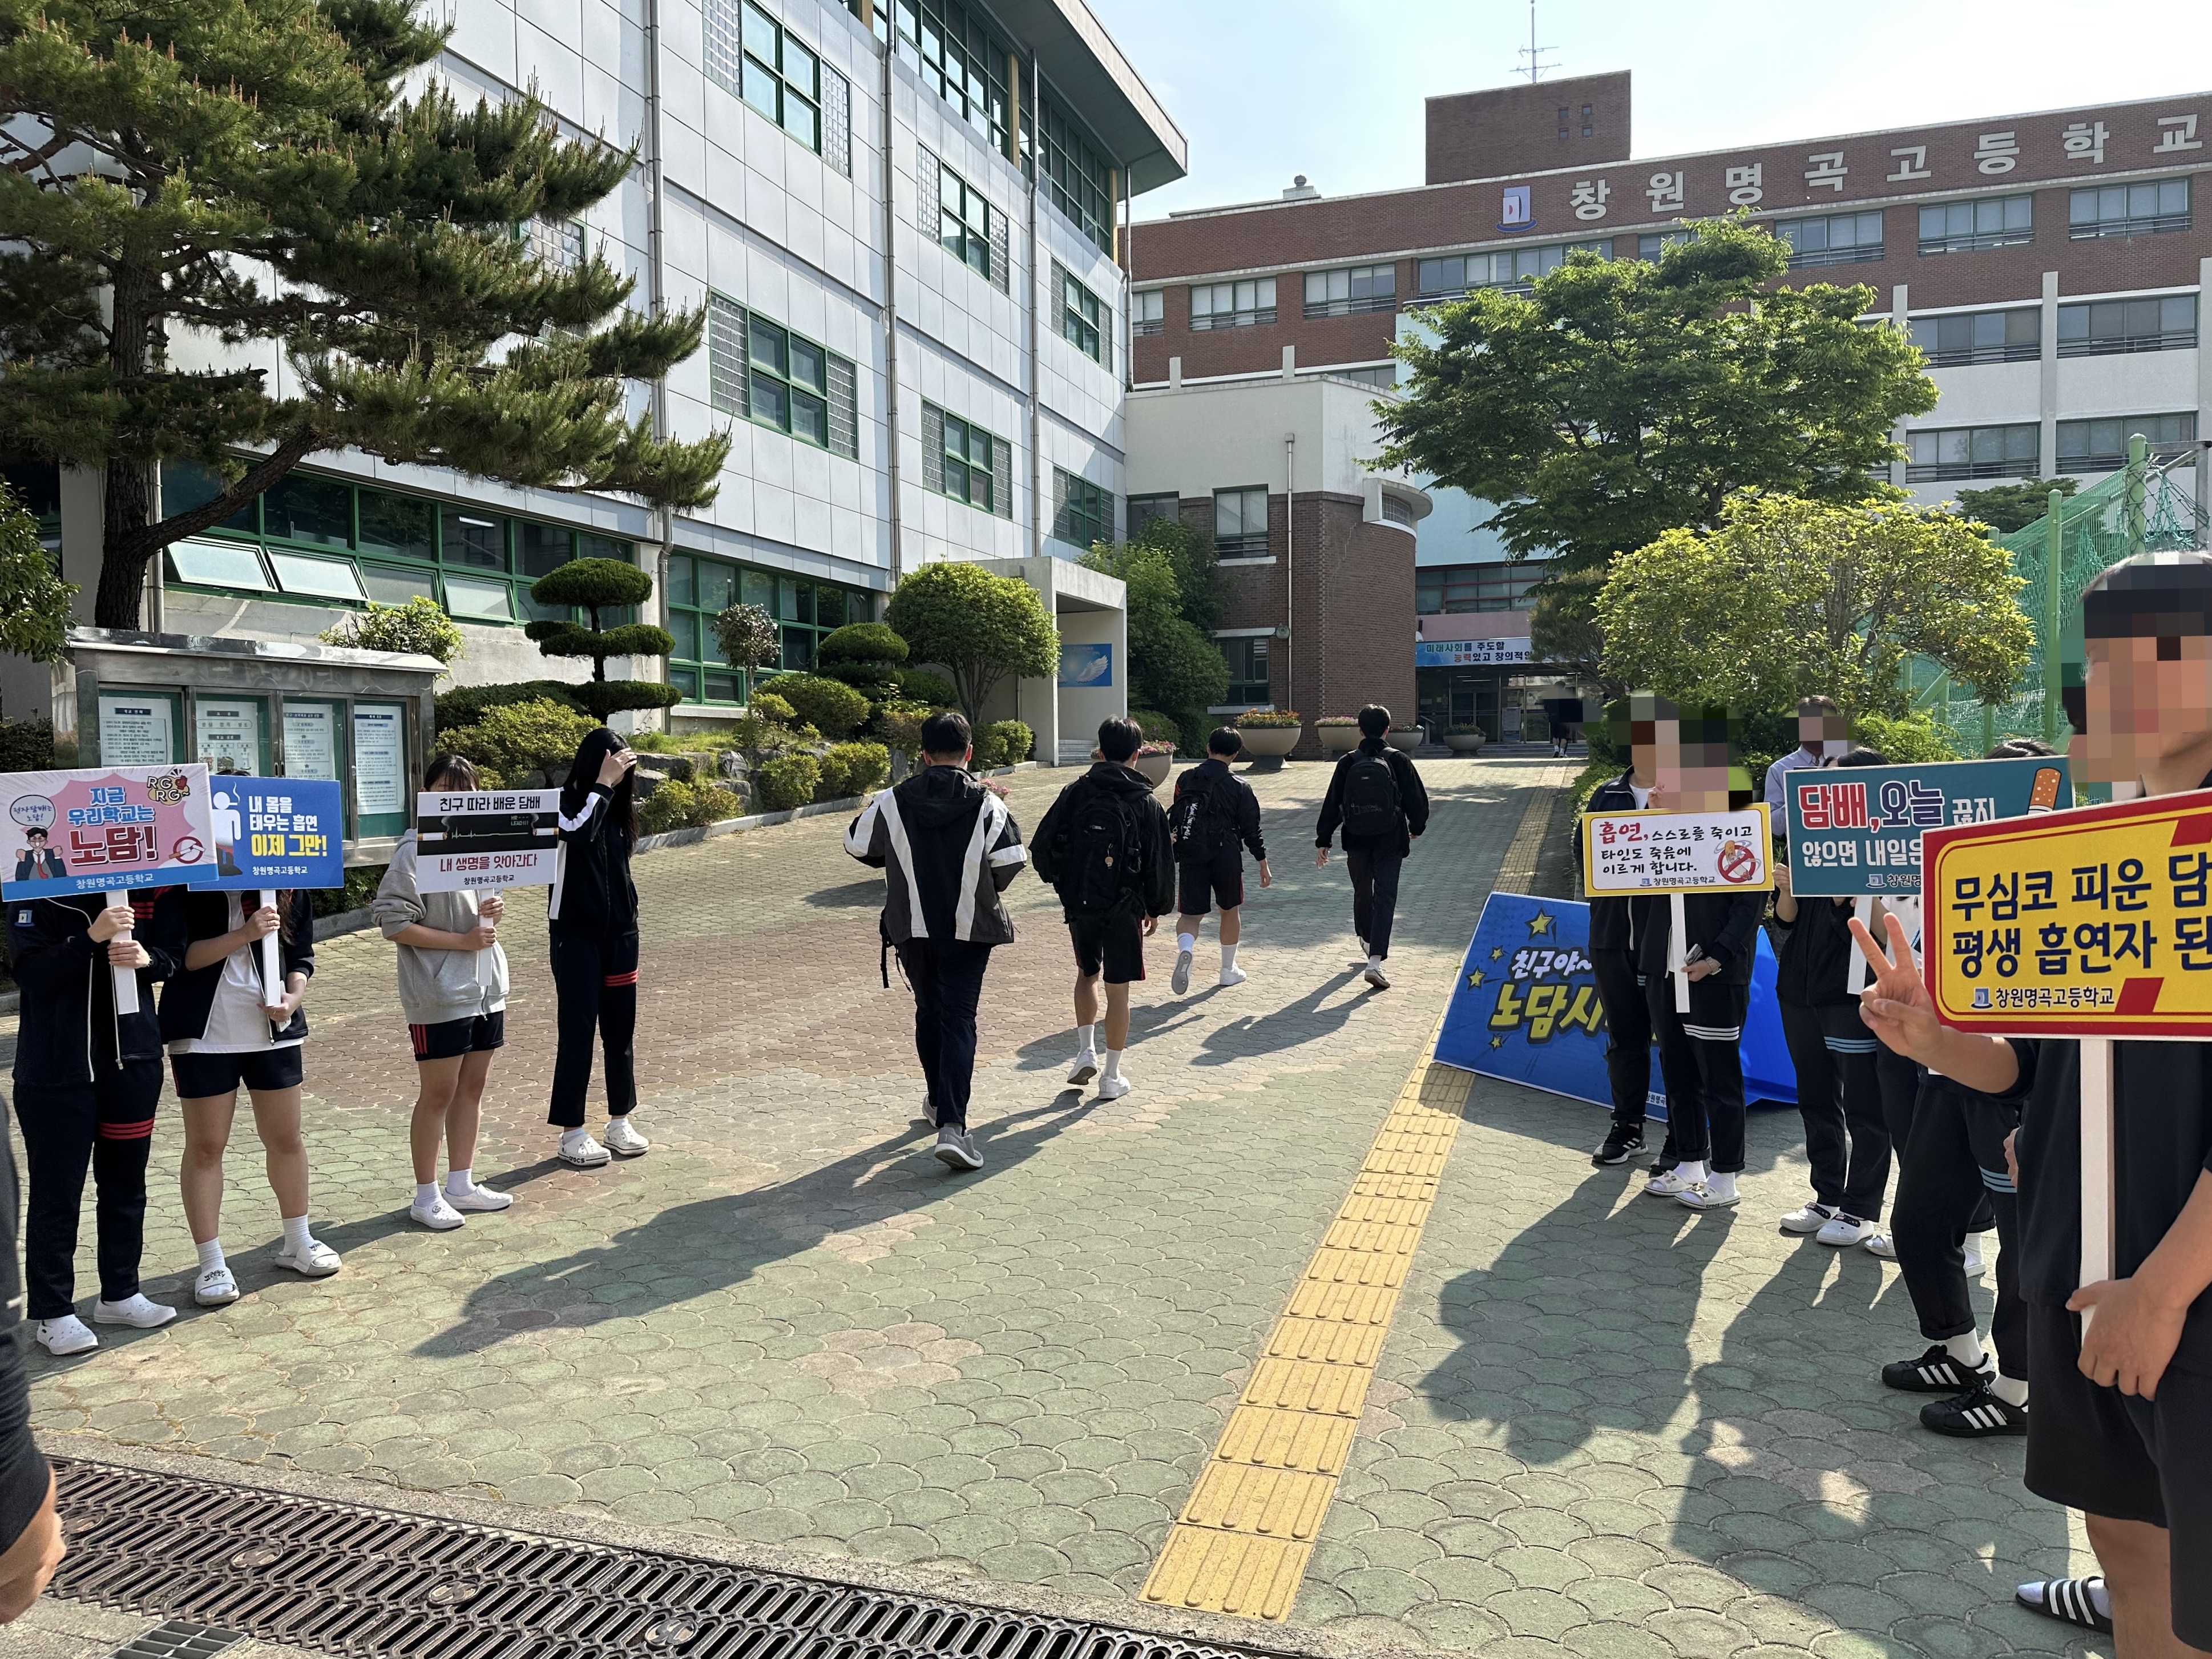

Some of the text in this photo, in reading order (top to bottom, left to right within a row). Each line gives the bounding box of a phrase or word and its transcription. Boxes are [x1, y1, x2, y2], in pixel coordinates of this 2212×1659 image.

[1569, 113, 2202, 221] 창원명곡고등학교
[1426, 641, 1505, 653] 미래사회를 주도할
[1454, 653, 1491, 663] 능력있고
[147, 775, 173, 790] RG
[90, 786, 126, 806] 지금
[249, 796, 292, 813] 내 몸을
[440, 796, 540, 812] 친구 따라 배운 담배
[68, 805, 155, 827] 우리학교는
[1952, 797, 1995, 825] 끊지
[249, 814, 318, 831] 태우는 흡연
[1599, 821, 1752, 844] 흡연, 스스로를 죽이고
[69, 826, 159, 866] 노담!
[251, 834, 327, 857] 이제 그만!
[1601, 846, 1691, 861] 타인도 죽음에
[1802, 839, 1858, 867] 않으면
[252, 866, 308, 875] 창원명곡고등학교
[440, 854, 538, 872] 내 생명을 앗아간다
[1603, 861, 1697, 875] 이르게 합니다.
[75, 874, 155, 890] 창원명곡고등학교
[464, 875, 515, 885] 창원명곡고등학교
[1653, 876, 1715, 886] 창원명곡고등학교
[1951, 851, 2212, 922] 무심코 피운 담
[1952, 927, 2021, 979] 평생
[2035, 920, 2157, 976] 흡연자
[1995, 986, 2116, 1008] 창원명곡고등학교
[1490, 983, 1608, 1040] 노담시
